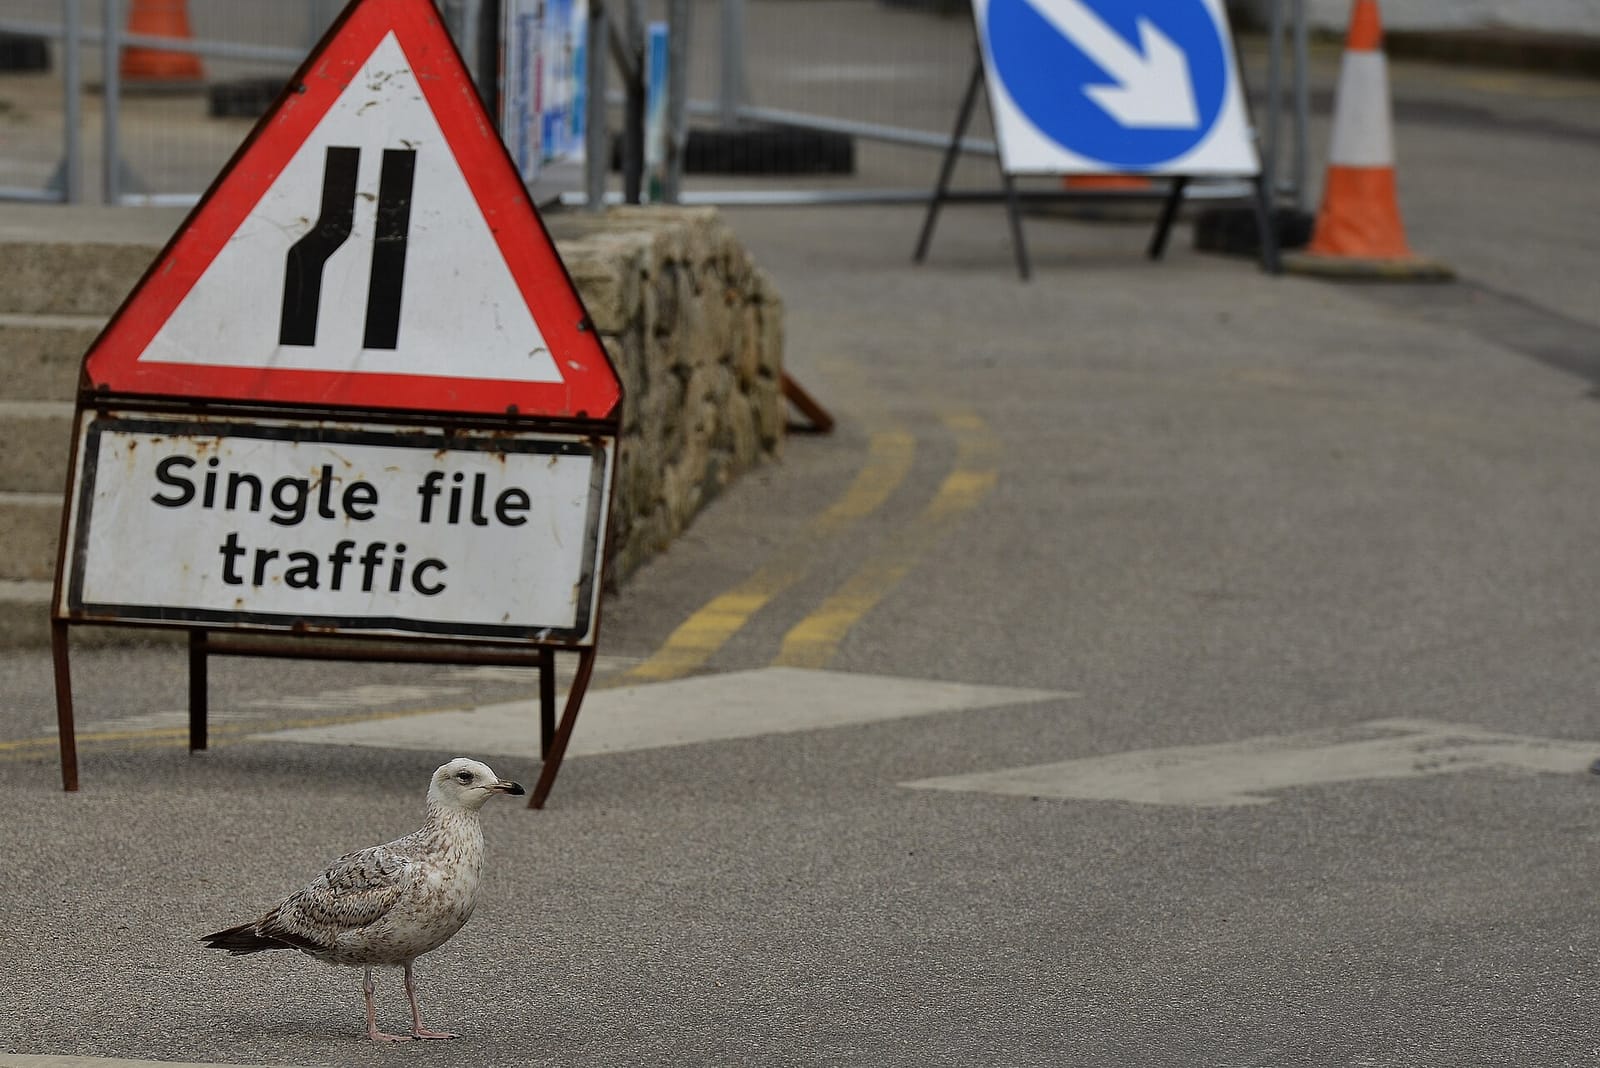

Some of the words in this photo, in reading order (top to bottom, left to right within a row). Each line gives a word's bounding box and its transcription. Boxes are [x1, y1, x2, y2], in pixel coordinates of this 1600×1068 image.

[151, 455, 379, 527] Single
[417, 470, 532, 527] file
[219, 532, 448, 596] traffic
